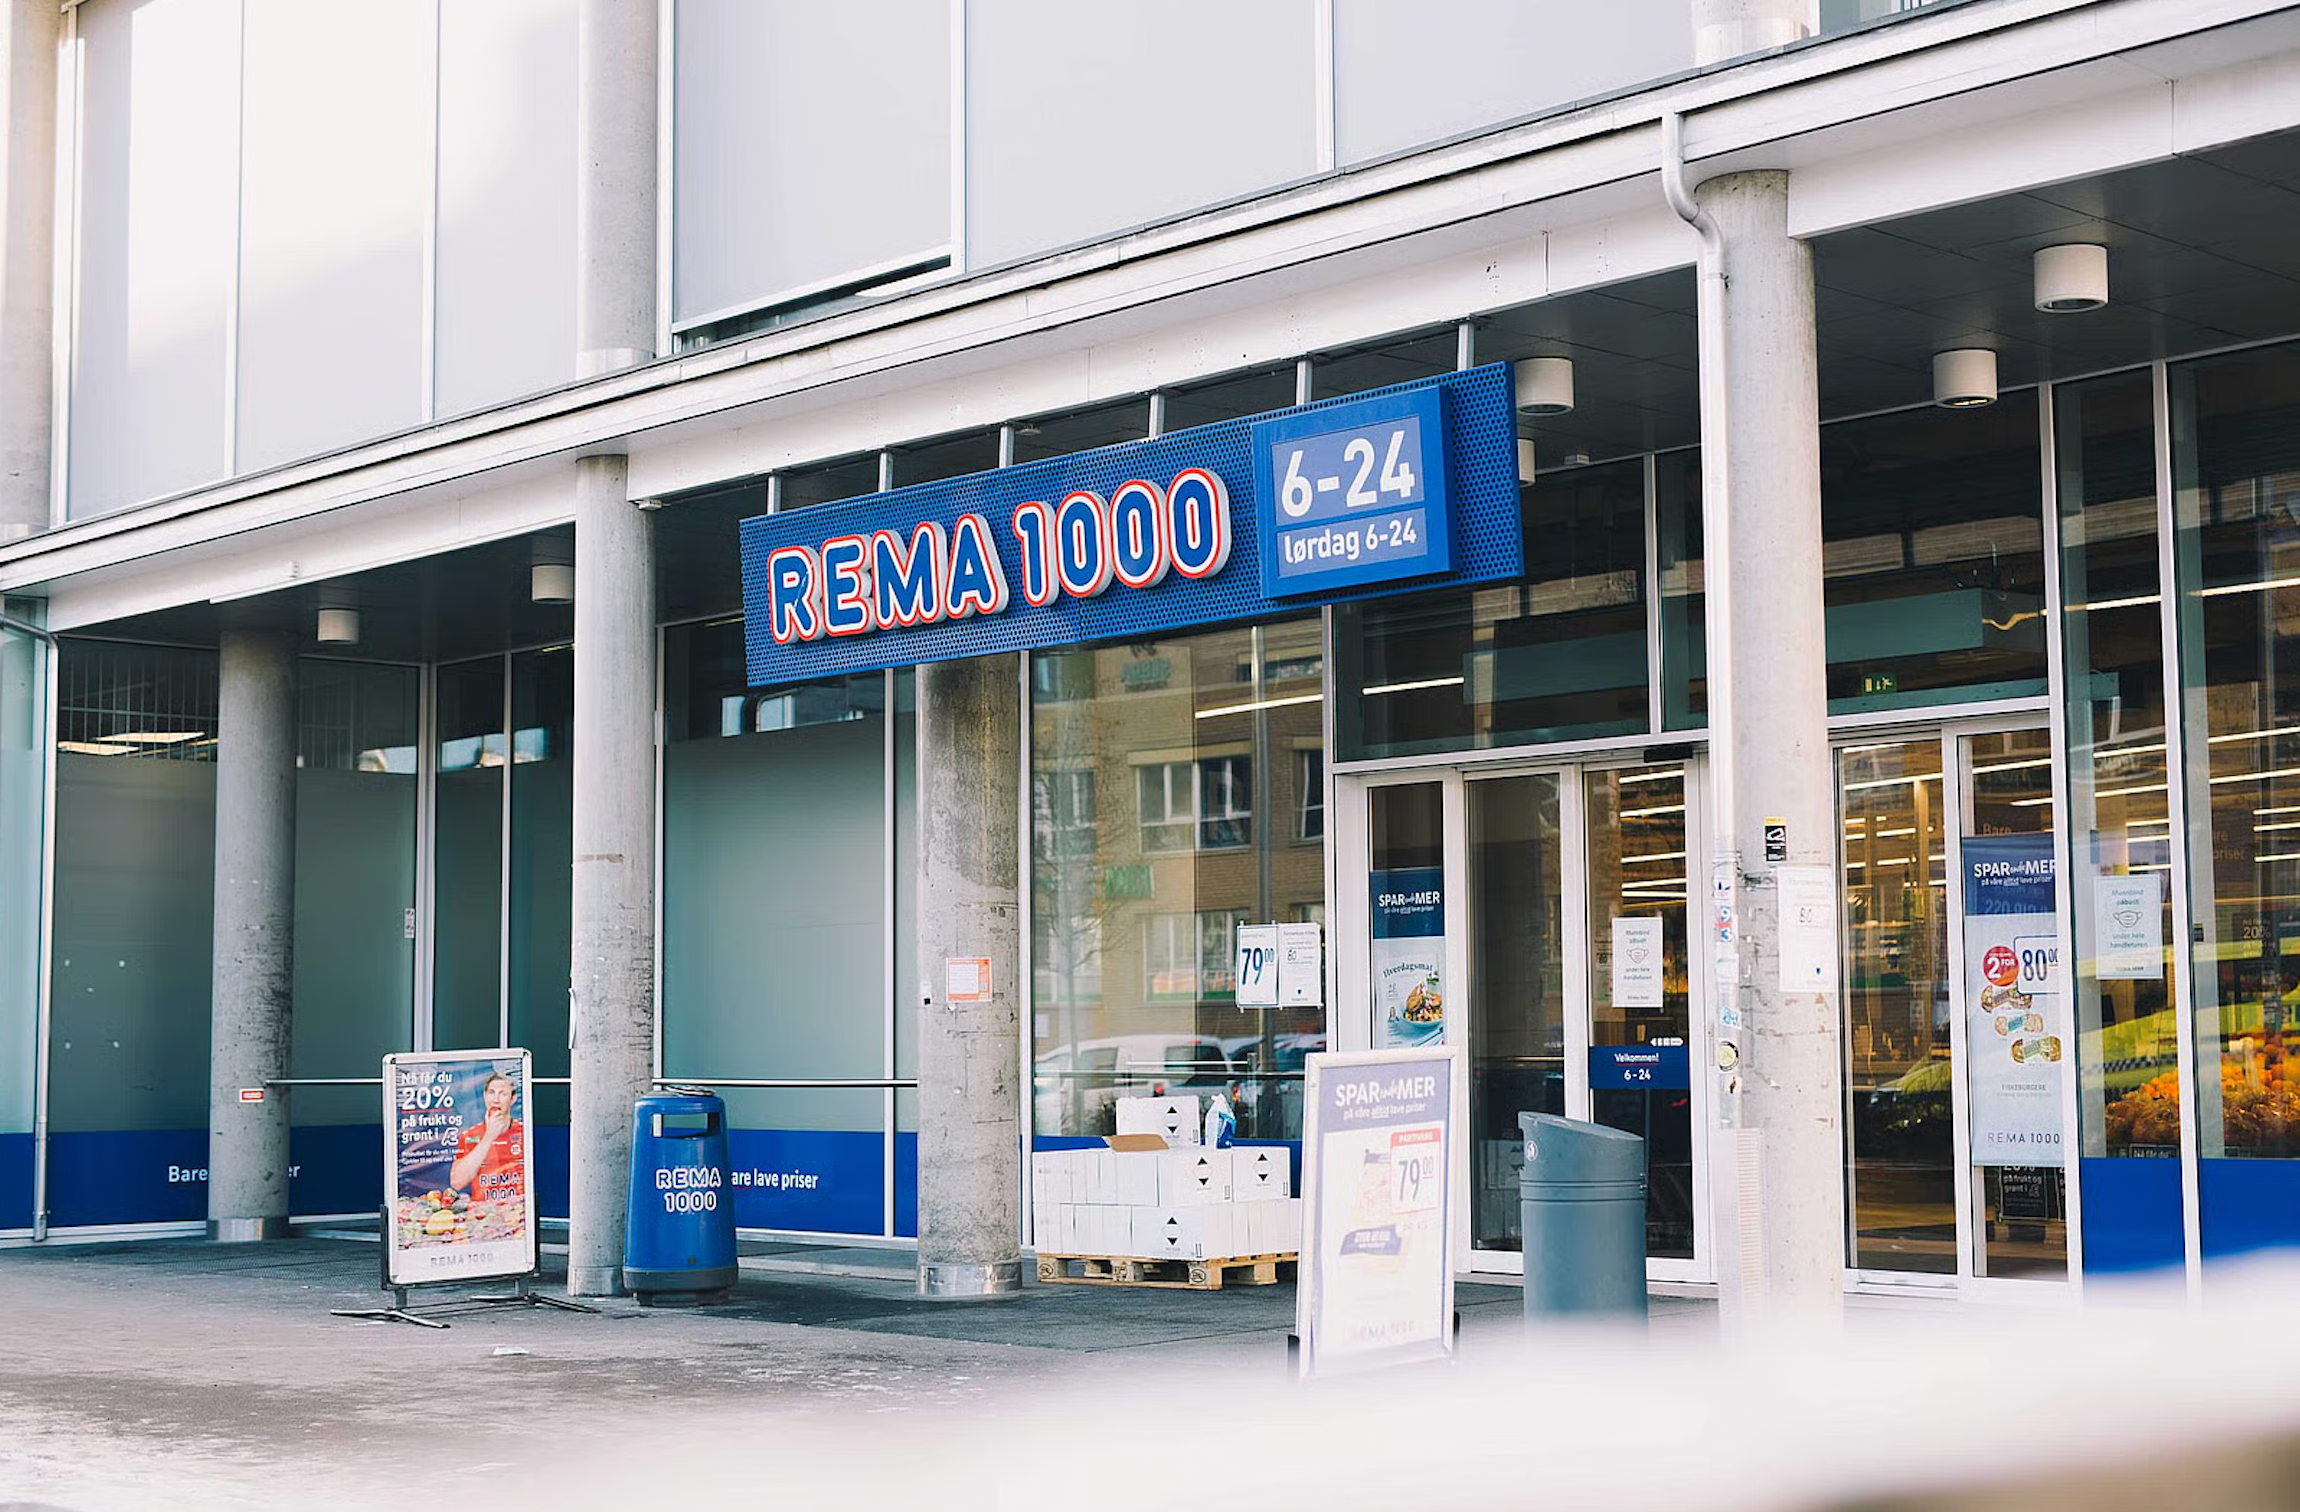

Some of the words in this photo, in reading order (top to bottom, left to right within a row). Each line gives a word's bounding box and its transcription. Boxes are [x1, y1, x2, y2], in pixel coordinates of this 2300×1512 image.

[1281, 430, 1416, 518] 6-24
[1284, 528, 1361, 563] lørdag
[1365, 517, 1417, 551] 6-24
[767, 512, 1008, 646] REMA
[1012, 467, 1230, 608] 1000
[1973, 861, 2011, 878] SPAR
[1378, 893, 1405, 907] SPAR
[1415, 890, 1440, 904] MER
[1241, 947, 1264, 986] 79
[1987, 955, 2002, 980] 2
[2022, 948, 2047, 982] 80
[1613, 1051, 1660, 1063] Velkommen!
[400, 1072, 418, 1086] Nå
[437, 1071, 452, 1083] du
[401, 1084, 454, 1111] 20%
[1335, 1081, 1380, 1107] SPAR
[1397, 1075, 1436, 1101] MER
[401, 1114, 417, 1130] på
[419, 1113, 447, 1127] frukt
[448, 1114, 463, 1126] og
[402, 1126, 433, 1145] grønt
[1987, 1132, 2026, 1143] REMA
[2030, 1132, 2060, 1144] 1000
[168, 1165, 209, 1183] Bare
[480, 1172, 520, 1185] REMA
[655, 1167, 722, 1189] REMA
[753, 1168, 779, 1187] lave
[781, 1169, 819, 1191] priser
[1398, 1158, 1421, 1202] 79
[485, 1188, 516, 1201] 1000
[664, 1191, 717, 1213] 1000
[430, 1255, 465, 1268] REMA
[467, 1252, 494, 1265] 1000
